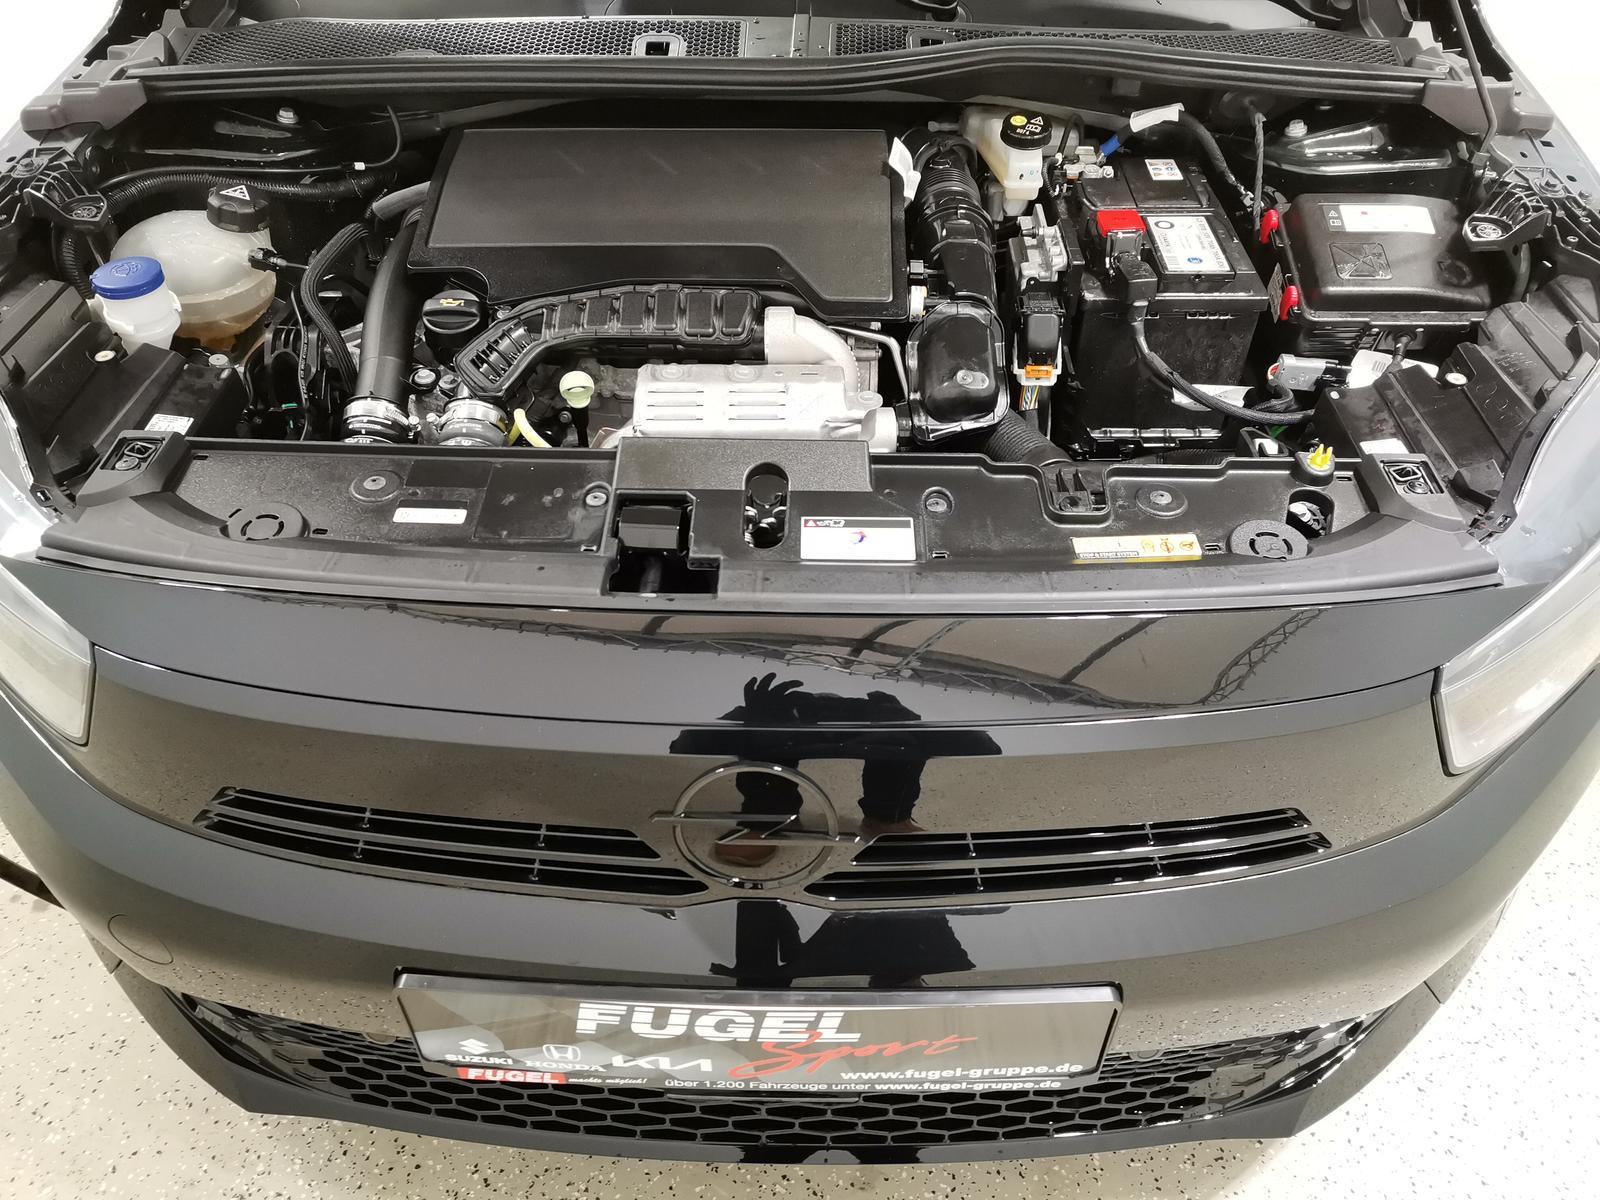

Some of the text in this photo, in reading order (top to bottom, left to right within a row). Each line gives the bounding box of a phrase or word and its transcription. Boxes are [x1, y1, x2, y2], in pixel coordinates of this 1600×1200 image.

[576, 1002, 861, 1043] FUGEL
[444, 1054, 513, 1065] SUZUKI
[727, 1030, 978, 1079] Sport
[525, 1060, 607, 1072] HONDA
[840, 1063, 1083, 1080] www.fugel-gruppe.de
[467, 1068, 560, 1084] FUGEL
[665, 1078, 1062, 1091] über 1.200 Fahrzeuge unter www.fugel-gruppe.de
